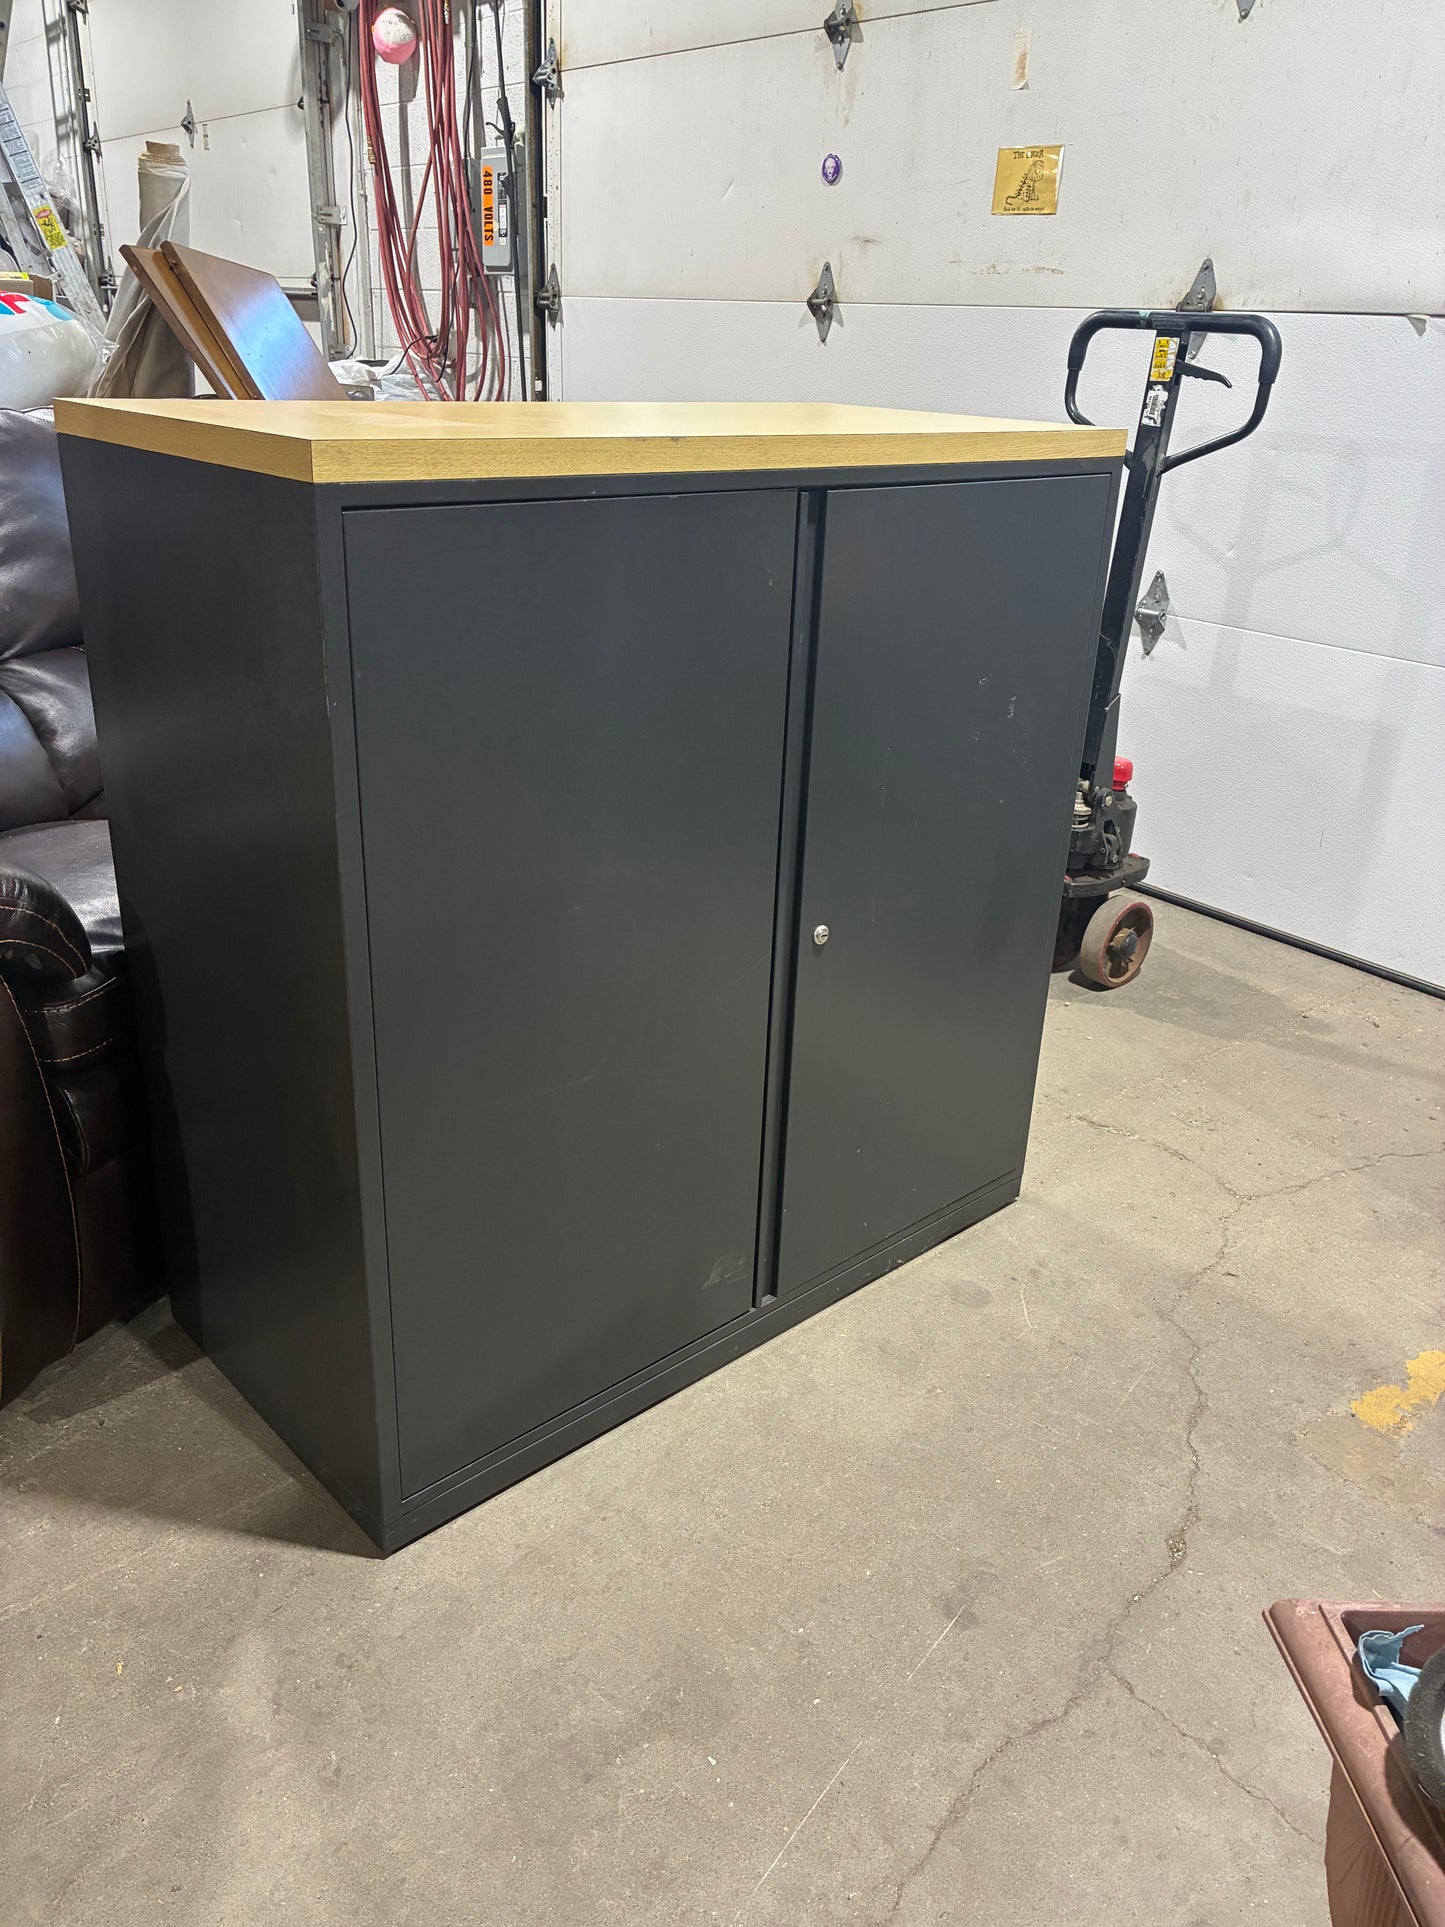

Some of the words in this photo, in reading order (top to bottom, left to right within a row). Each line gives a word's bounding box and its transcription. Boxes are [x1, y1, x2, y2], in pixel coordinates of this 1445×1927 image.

[1013, 151, 1025, 159] THE
[483, 171, 493, 195] 480
[484, 206, 494, 241] VOLTS
